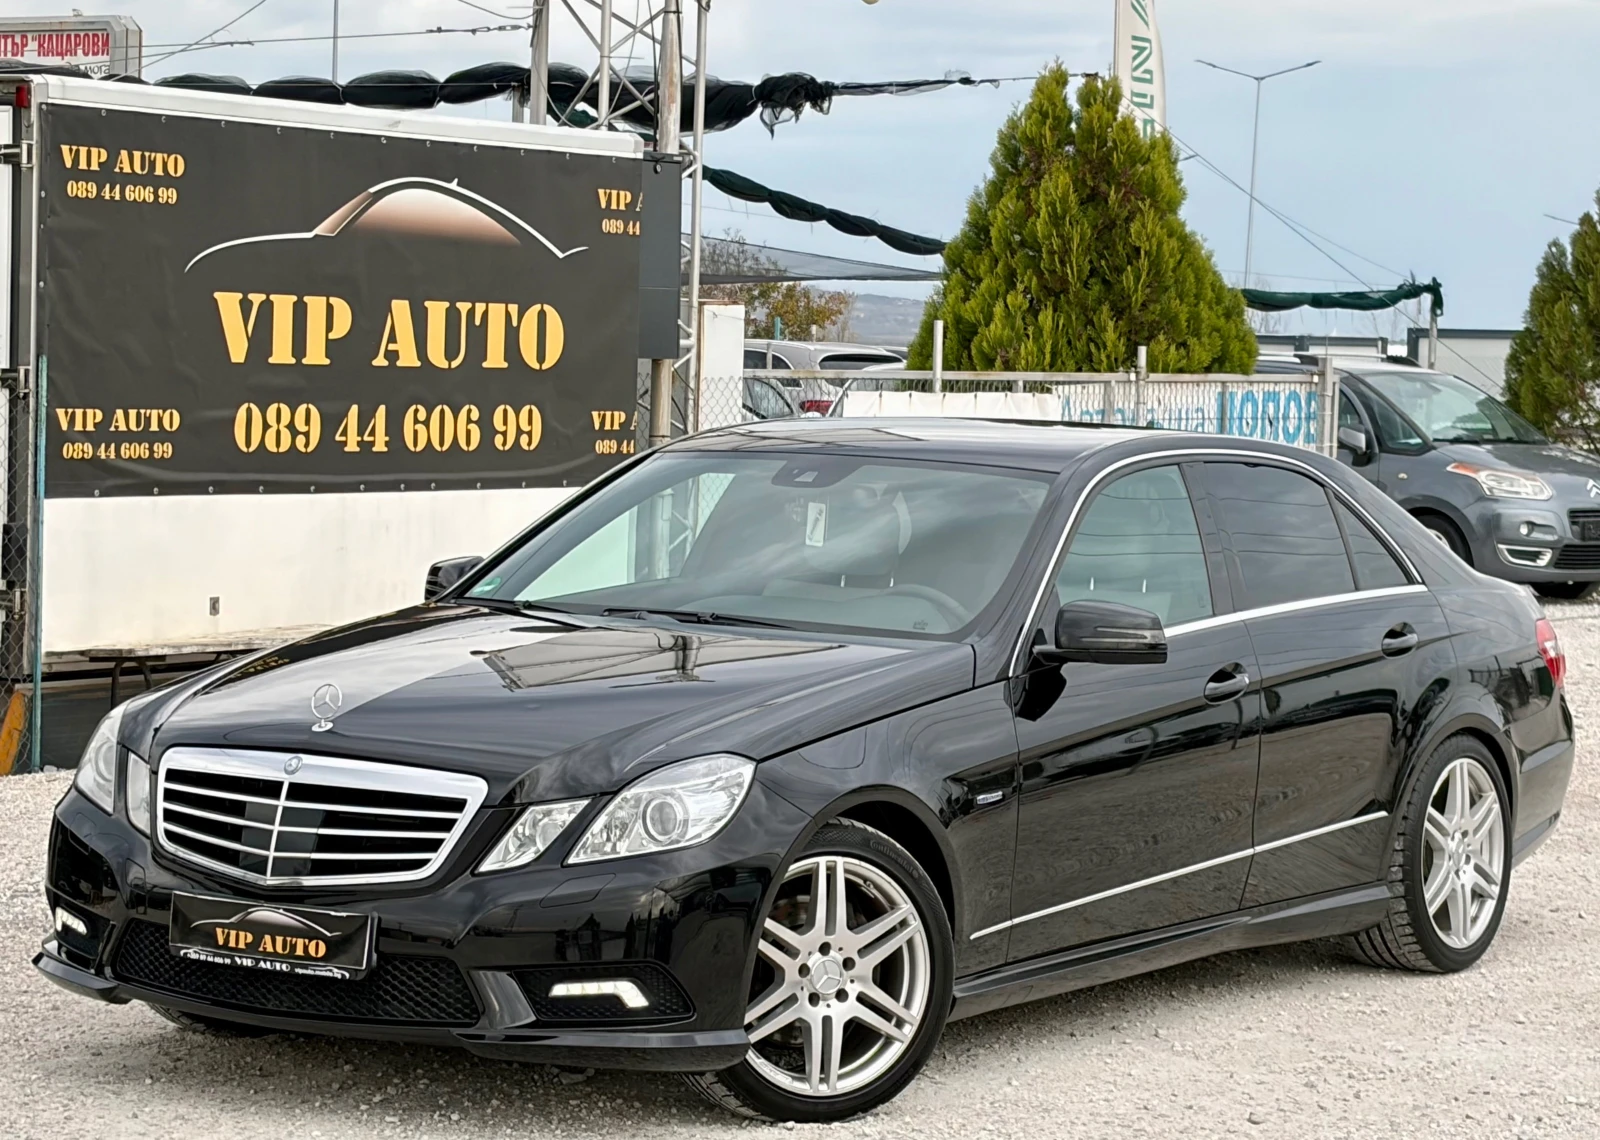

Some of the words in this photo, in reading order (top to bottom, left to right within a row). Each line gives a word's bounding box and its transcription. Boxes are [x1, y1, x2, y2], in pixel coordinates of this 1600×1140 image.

[0, 34, 29, 58] ТЪР
[61, 145, 107, 171] VIP
[113, 149, 185, 178] AUTO
[67, 180, 97, 199] 089
[101, 183, 121, 201] 44
[125, 186, 155, 203] 606
[158, 187, 178, 204] 99
[597, 188, 632, 211] VIP
[602, 218, 625, 234] 089
[627, 220, 641, 236] 44
[214, 292, 353, 366] VIP
[371, 299, 565, 371] AUTO
[56, 408, 103, 432] VIP
[109, 408, 181, 432] AUTO
[234, 402, 321, 454] 089
[334, 405, 390, 453] 44
[403, 404, 482, 453] 606
[492, 404, 543, 452] 99
[591, 410, 626, 431] VIP
[62, 443, 94, 459] 089
[97, 442, 116, 459] 44
[120, 443, 150, 459] 606
[153, 443, 174, 459] 99
[595, 439, 618, 454] 089
[620, 439, 635, 454] 44
[215, 927, 254, 949] VIP
[258, 935, 327, 958] AUTO
[234, 955, 256, 967] VIP
[257, 959, 291, 972] AUTO
